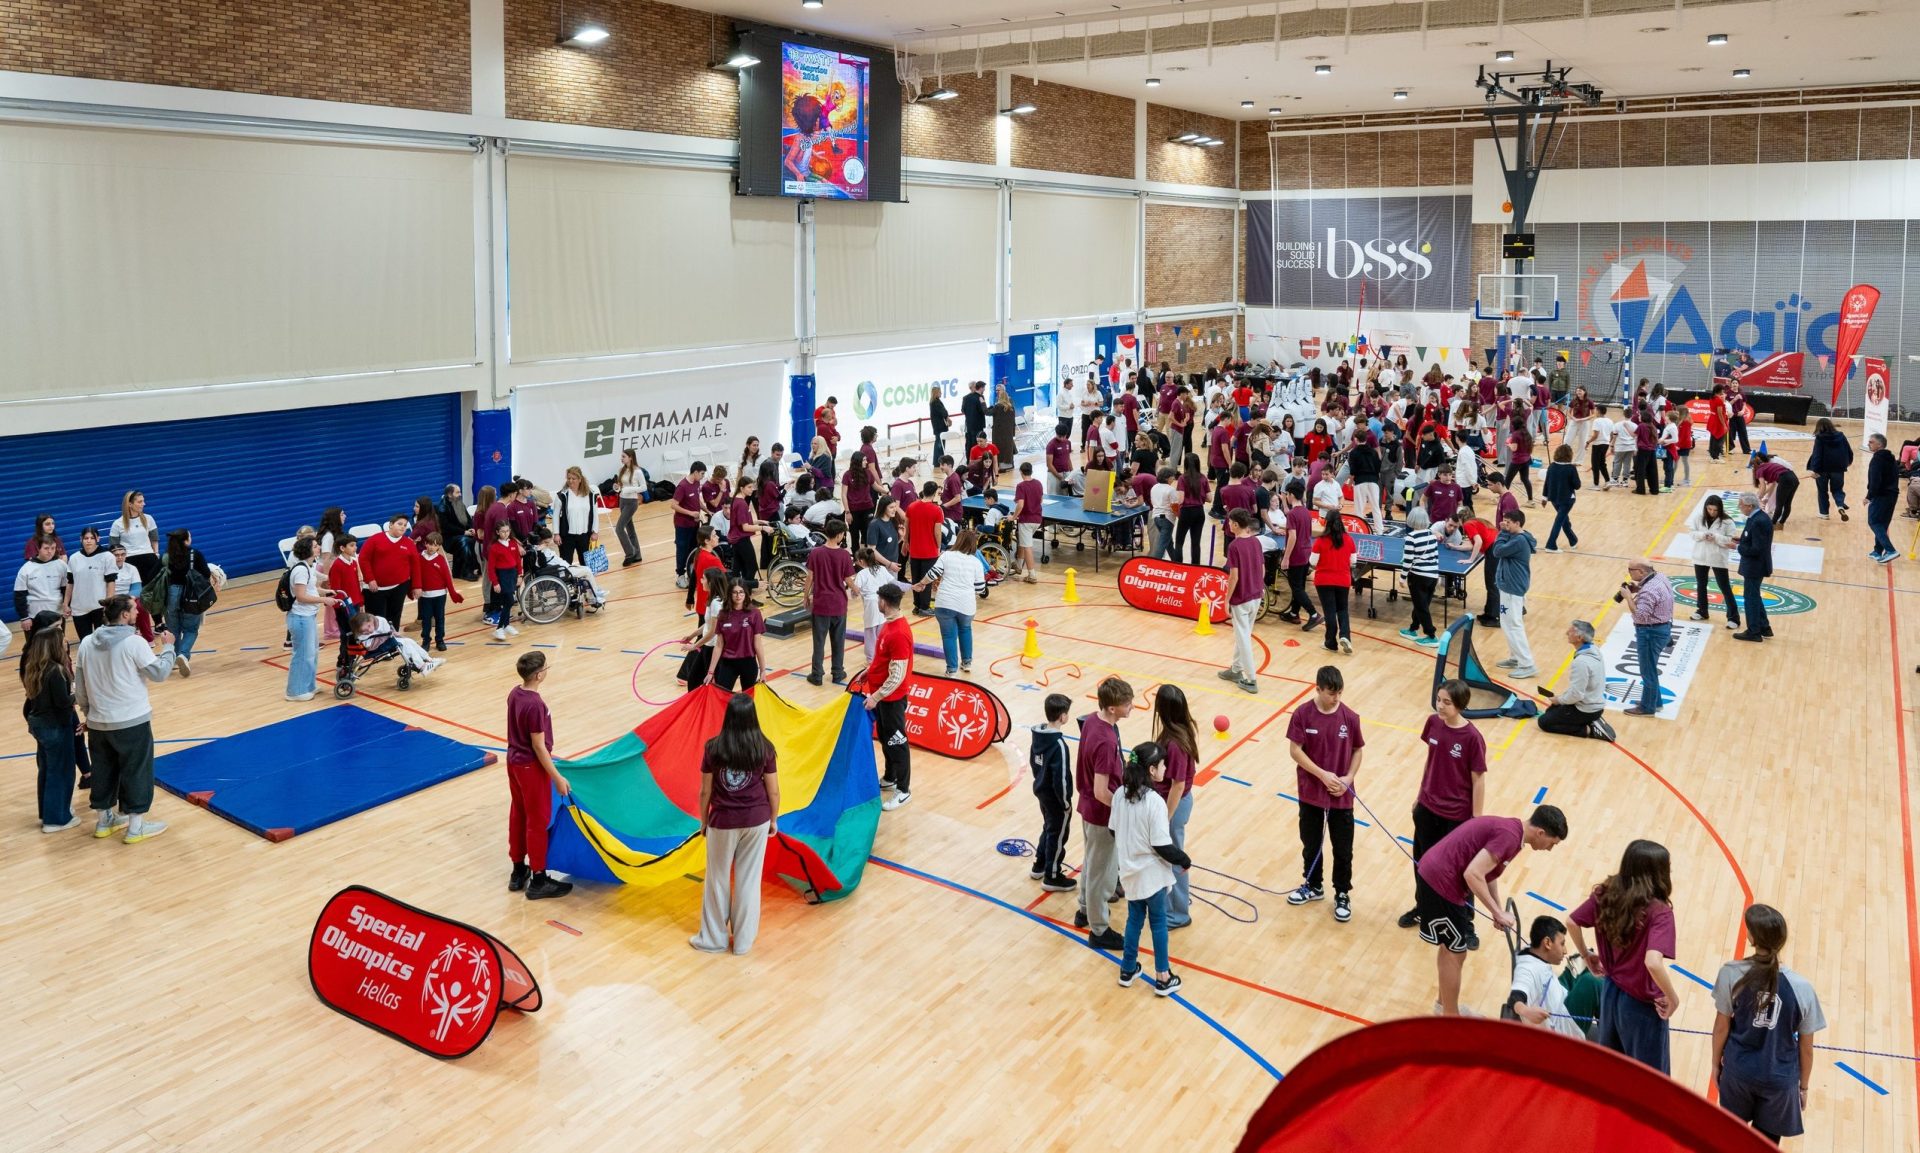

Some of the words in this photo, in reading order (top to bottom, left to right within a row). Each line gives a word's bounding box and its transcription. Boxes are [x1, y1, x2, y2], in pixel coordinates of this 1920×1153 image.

[1276, 242, 1315, 251] BUILDING
[1290, 251, 1315, 260] SOLID
[1326, 227, 1433, 281] bss
[1276, 260, 1315, 269] SUCCESS
[1070, 364, 1089, 375] ΟΡΙΖΩ
[620, 402, 729, 434] ΜΠΑΛΛΙΑΝ
[620, 428, 691, 451] ΤΕΧΝΙΚΗ
[698, 422, 727, 441] Α.Ε.
[1137, 564, 1188, 582] Special
[1124, 575, 1186, 595] Olympics
[1156, 594, 1183, 607] Hellas
[347, 904, 426, 952] Special
[321, 925, 415, 981] Olympics
[357, 976, 402, 1010] Hellas
